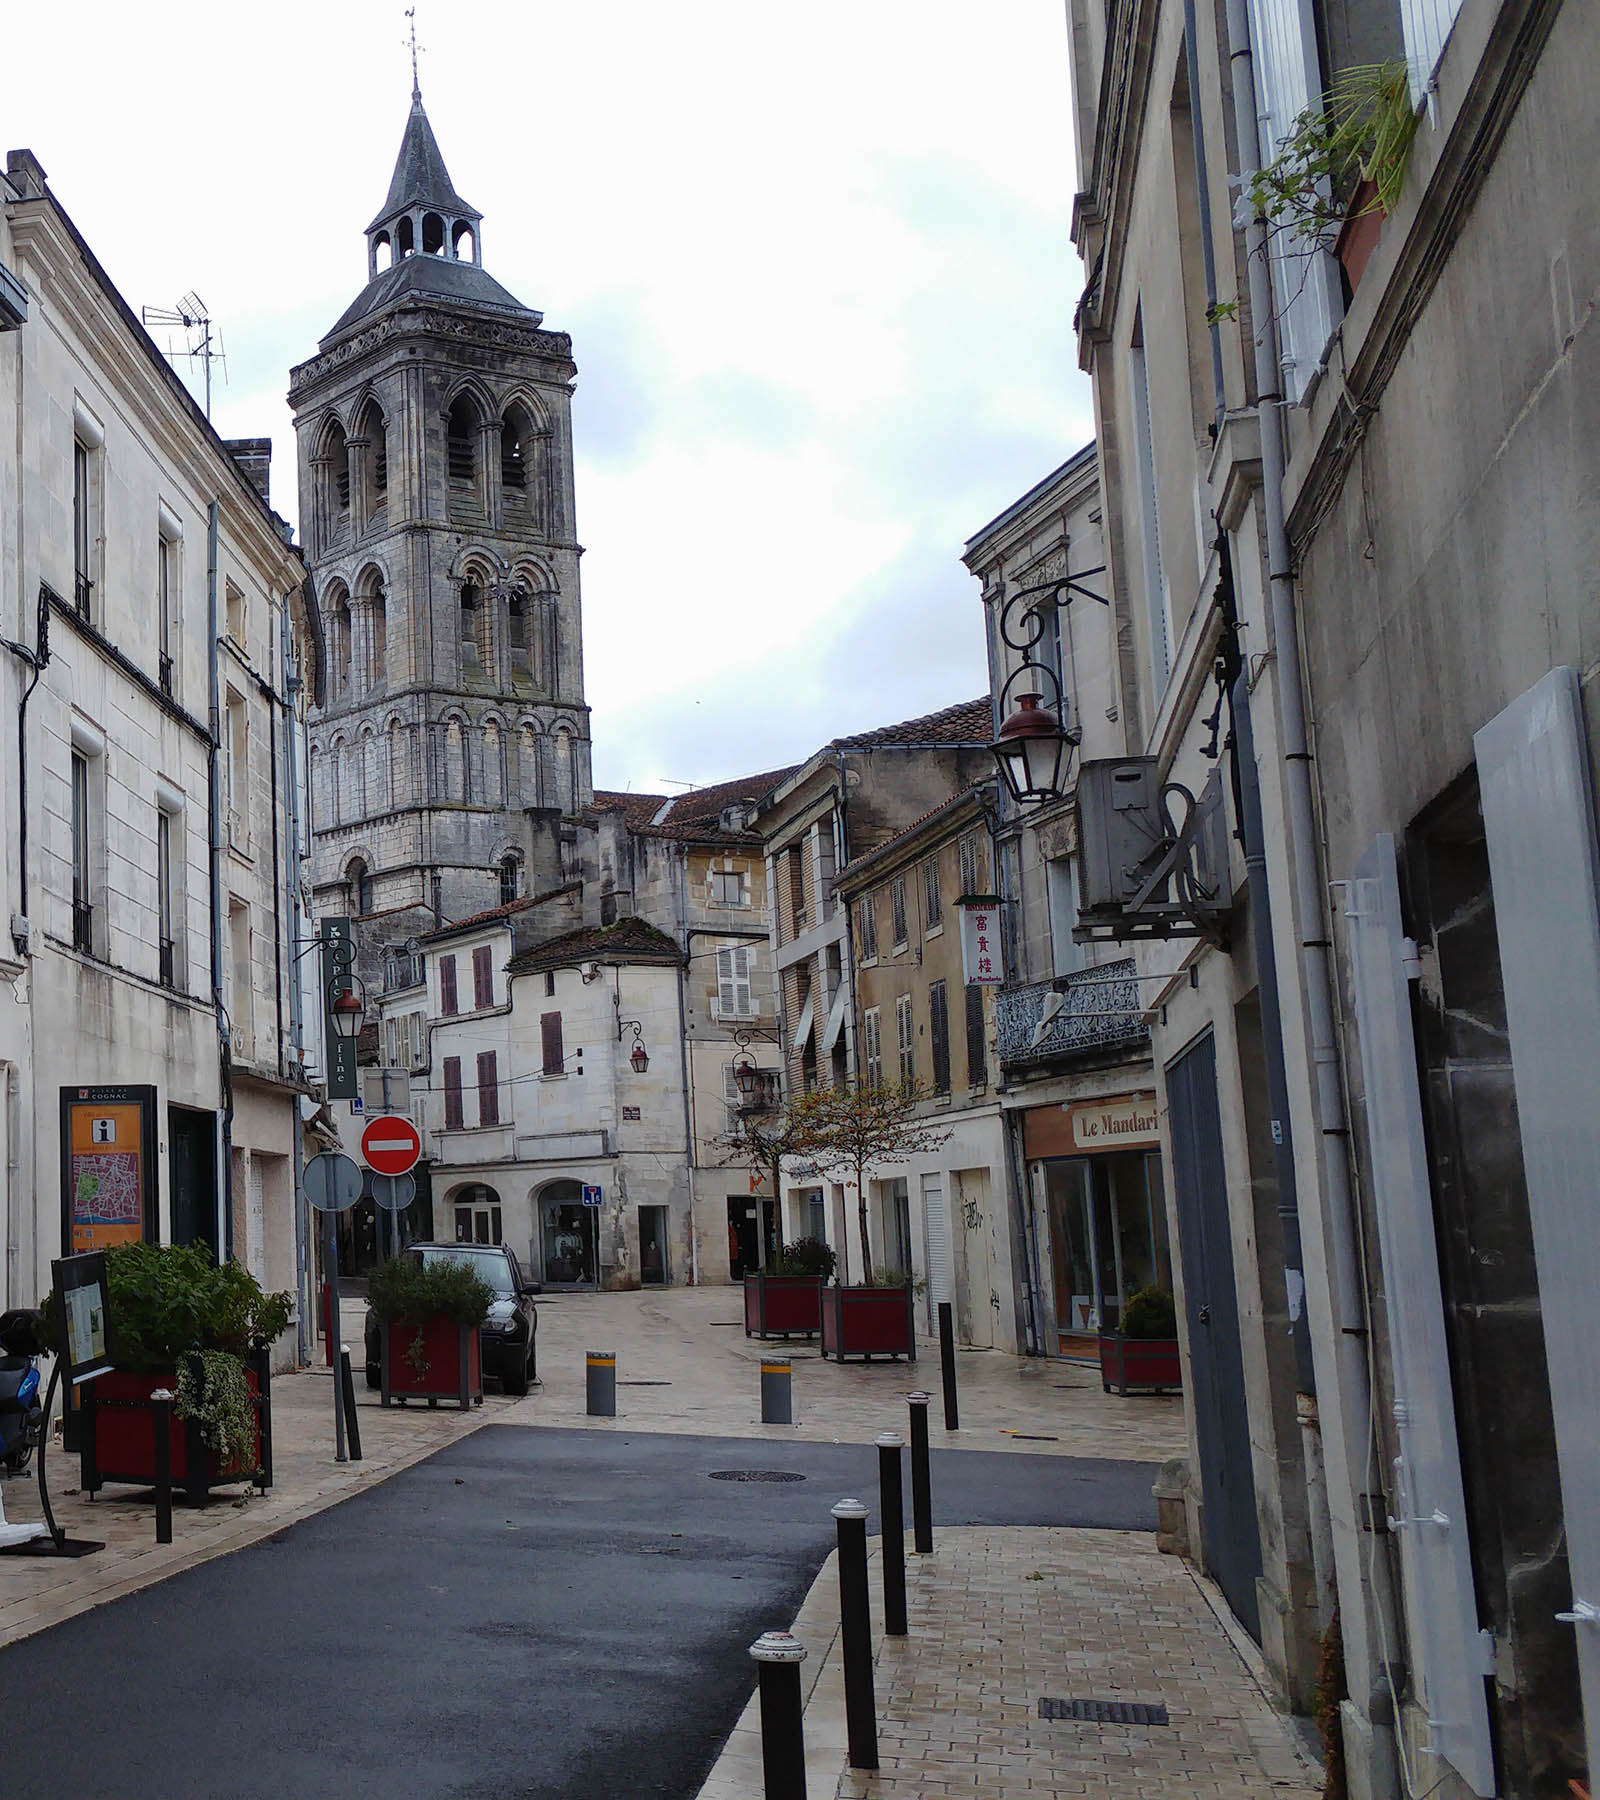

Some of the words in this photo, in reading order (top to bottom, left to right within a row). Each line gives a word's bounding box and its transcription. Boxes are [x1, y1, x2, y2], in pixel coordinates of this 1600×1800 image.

[335, 1043, 345, 1082] fine
[1080, 1116, 1098, 1137] Le
[1101, 1108, 1159, 1136] Mandari
